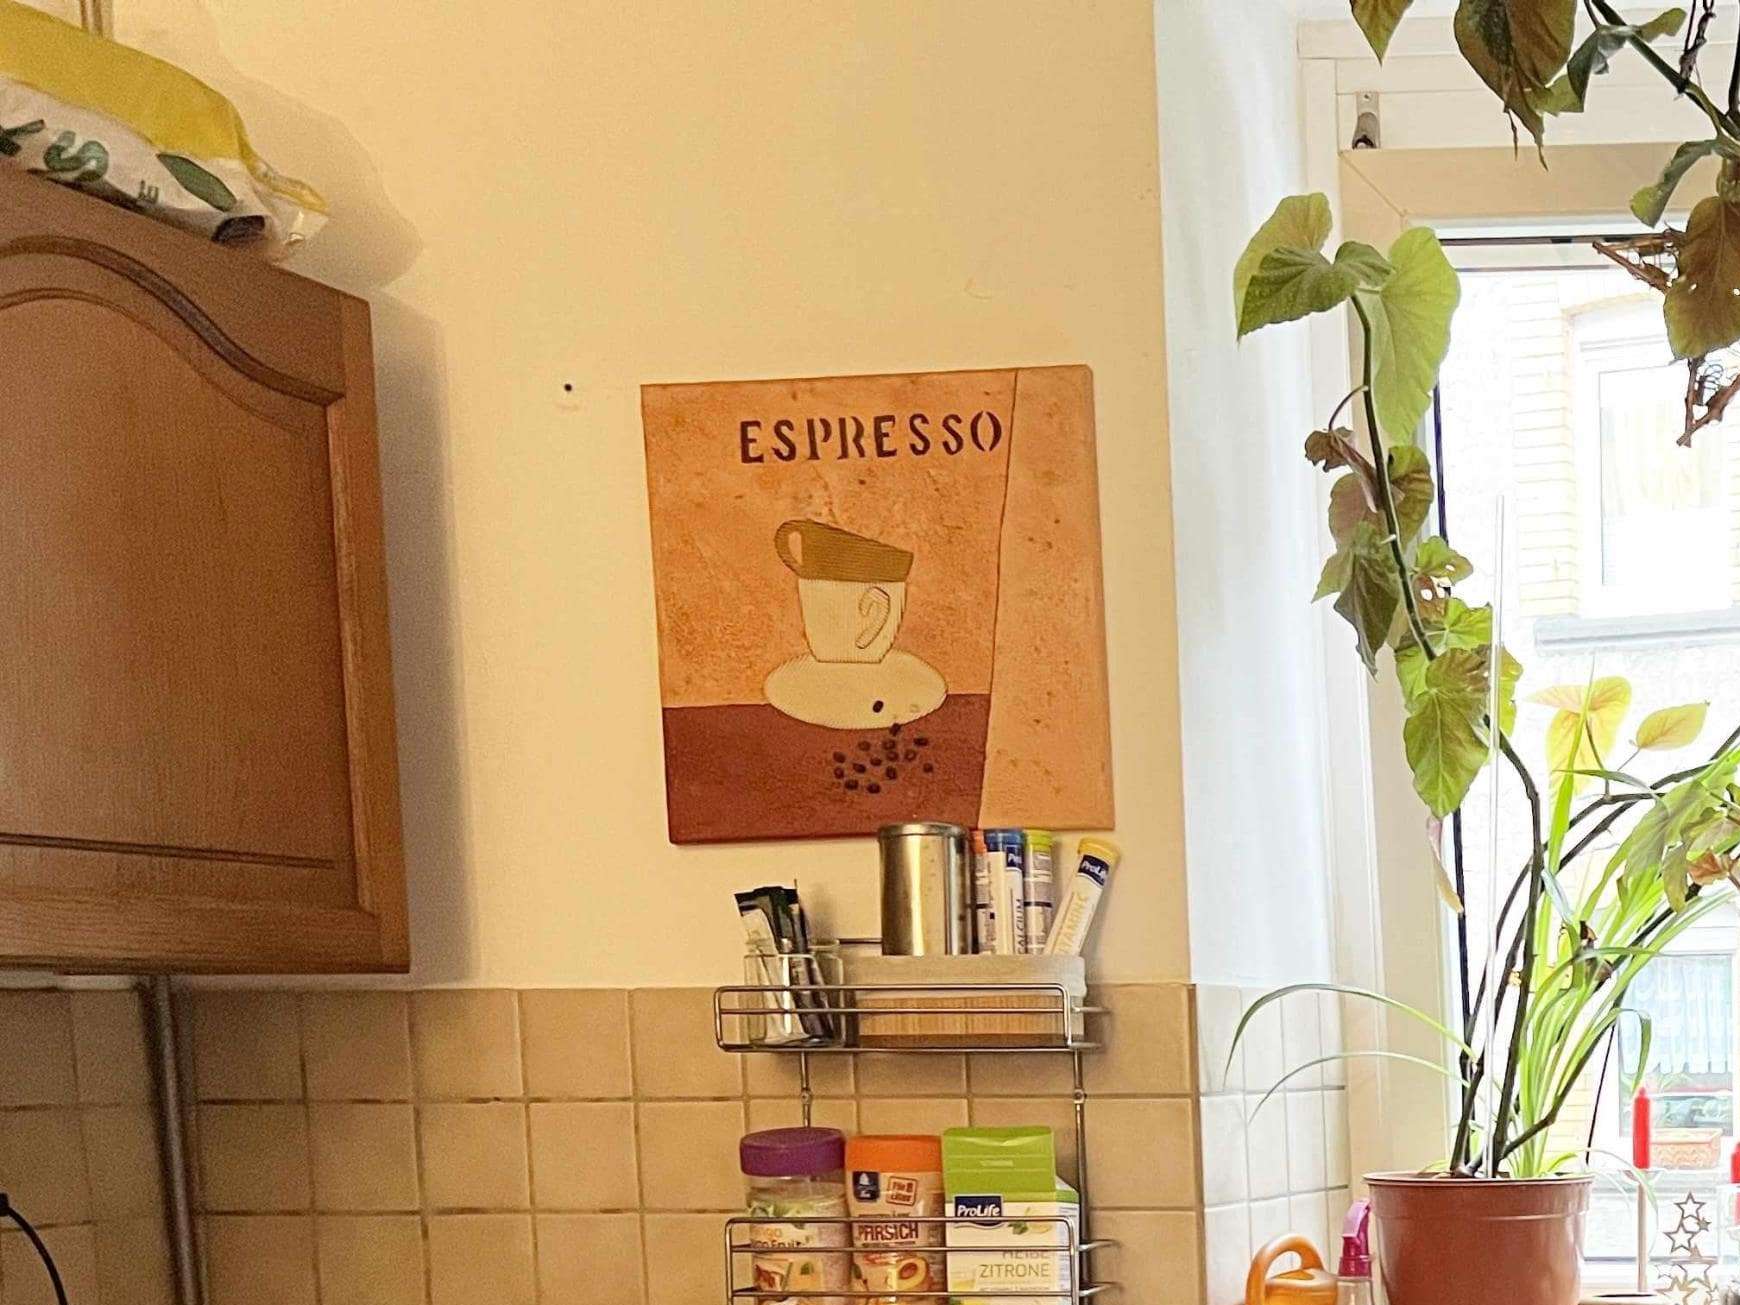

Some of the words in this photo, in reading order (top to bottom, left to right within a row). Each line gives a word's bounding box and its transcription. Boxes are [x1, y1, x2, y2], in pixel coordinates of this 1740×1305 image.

[740, 411, 1003, 464] ESPRESSO
[957, 1203, 1001, 1217] ProLife
[979, 1264, 1050, 1278] ZITRONE
